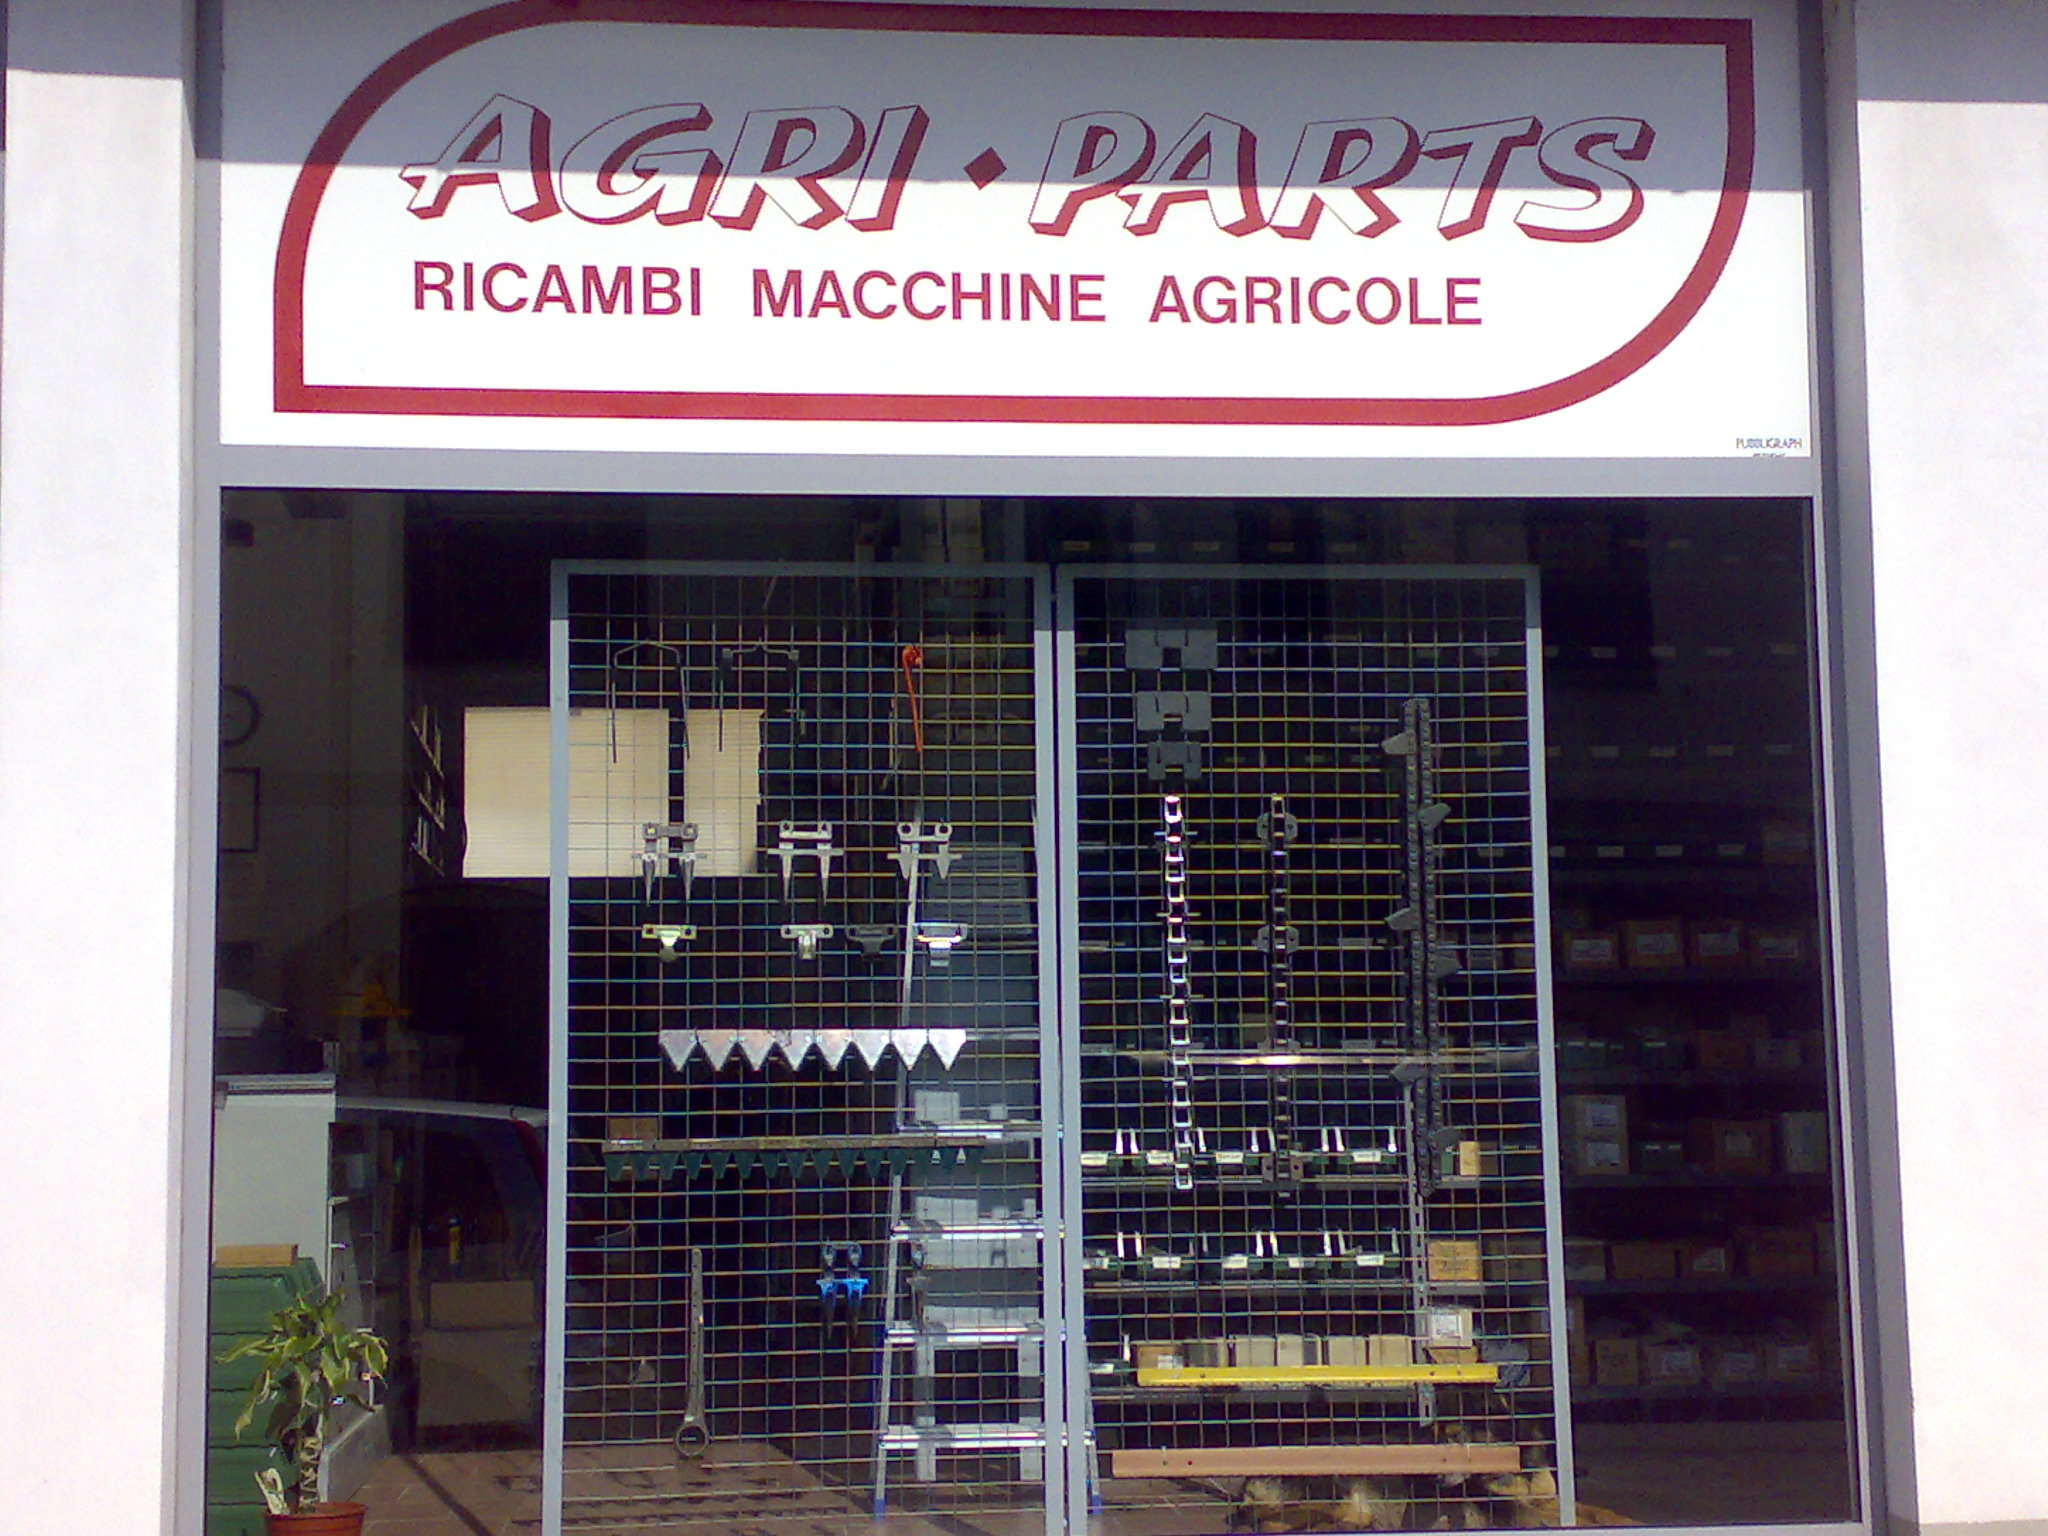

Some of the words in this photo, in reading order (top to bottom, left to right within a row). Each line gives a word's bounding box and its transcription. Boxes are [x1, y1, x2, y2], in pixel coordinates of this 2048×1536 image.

[400, 93, 929, 233] AGRI
[1028, 110, 1655, 244] PARTS
[413, 260, 702, 317] RICAMBI
[752, 267, 1107, 323] MACCHINE
[1148, 275, 1483, 326] AGRICOLE
